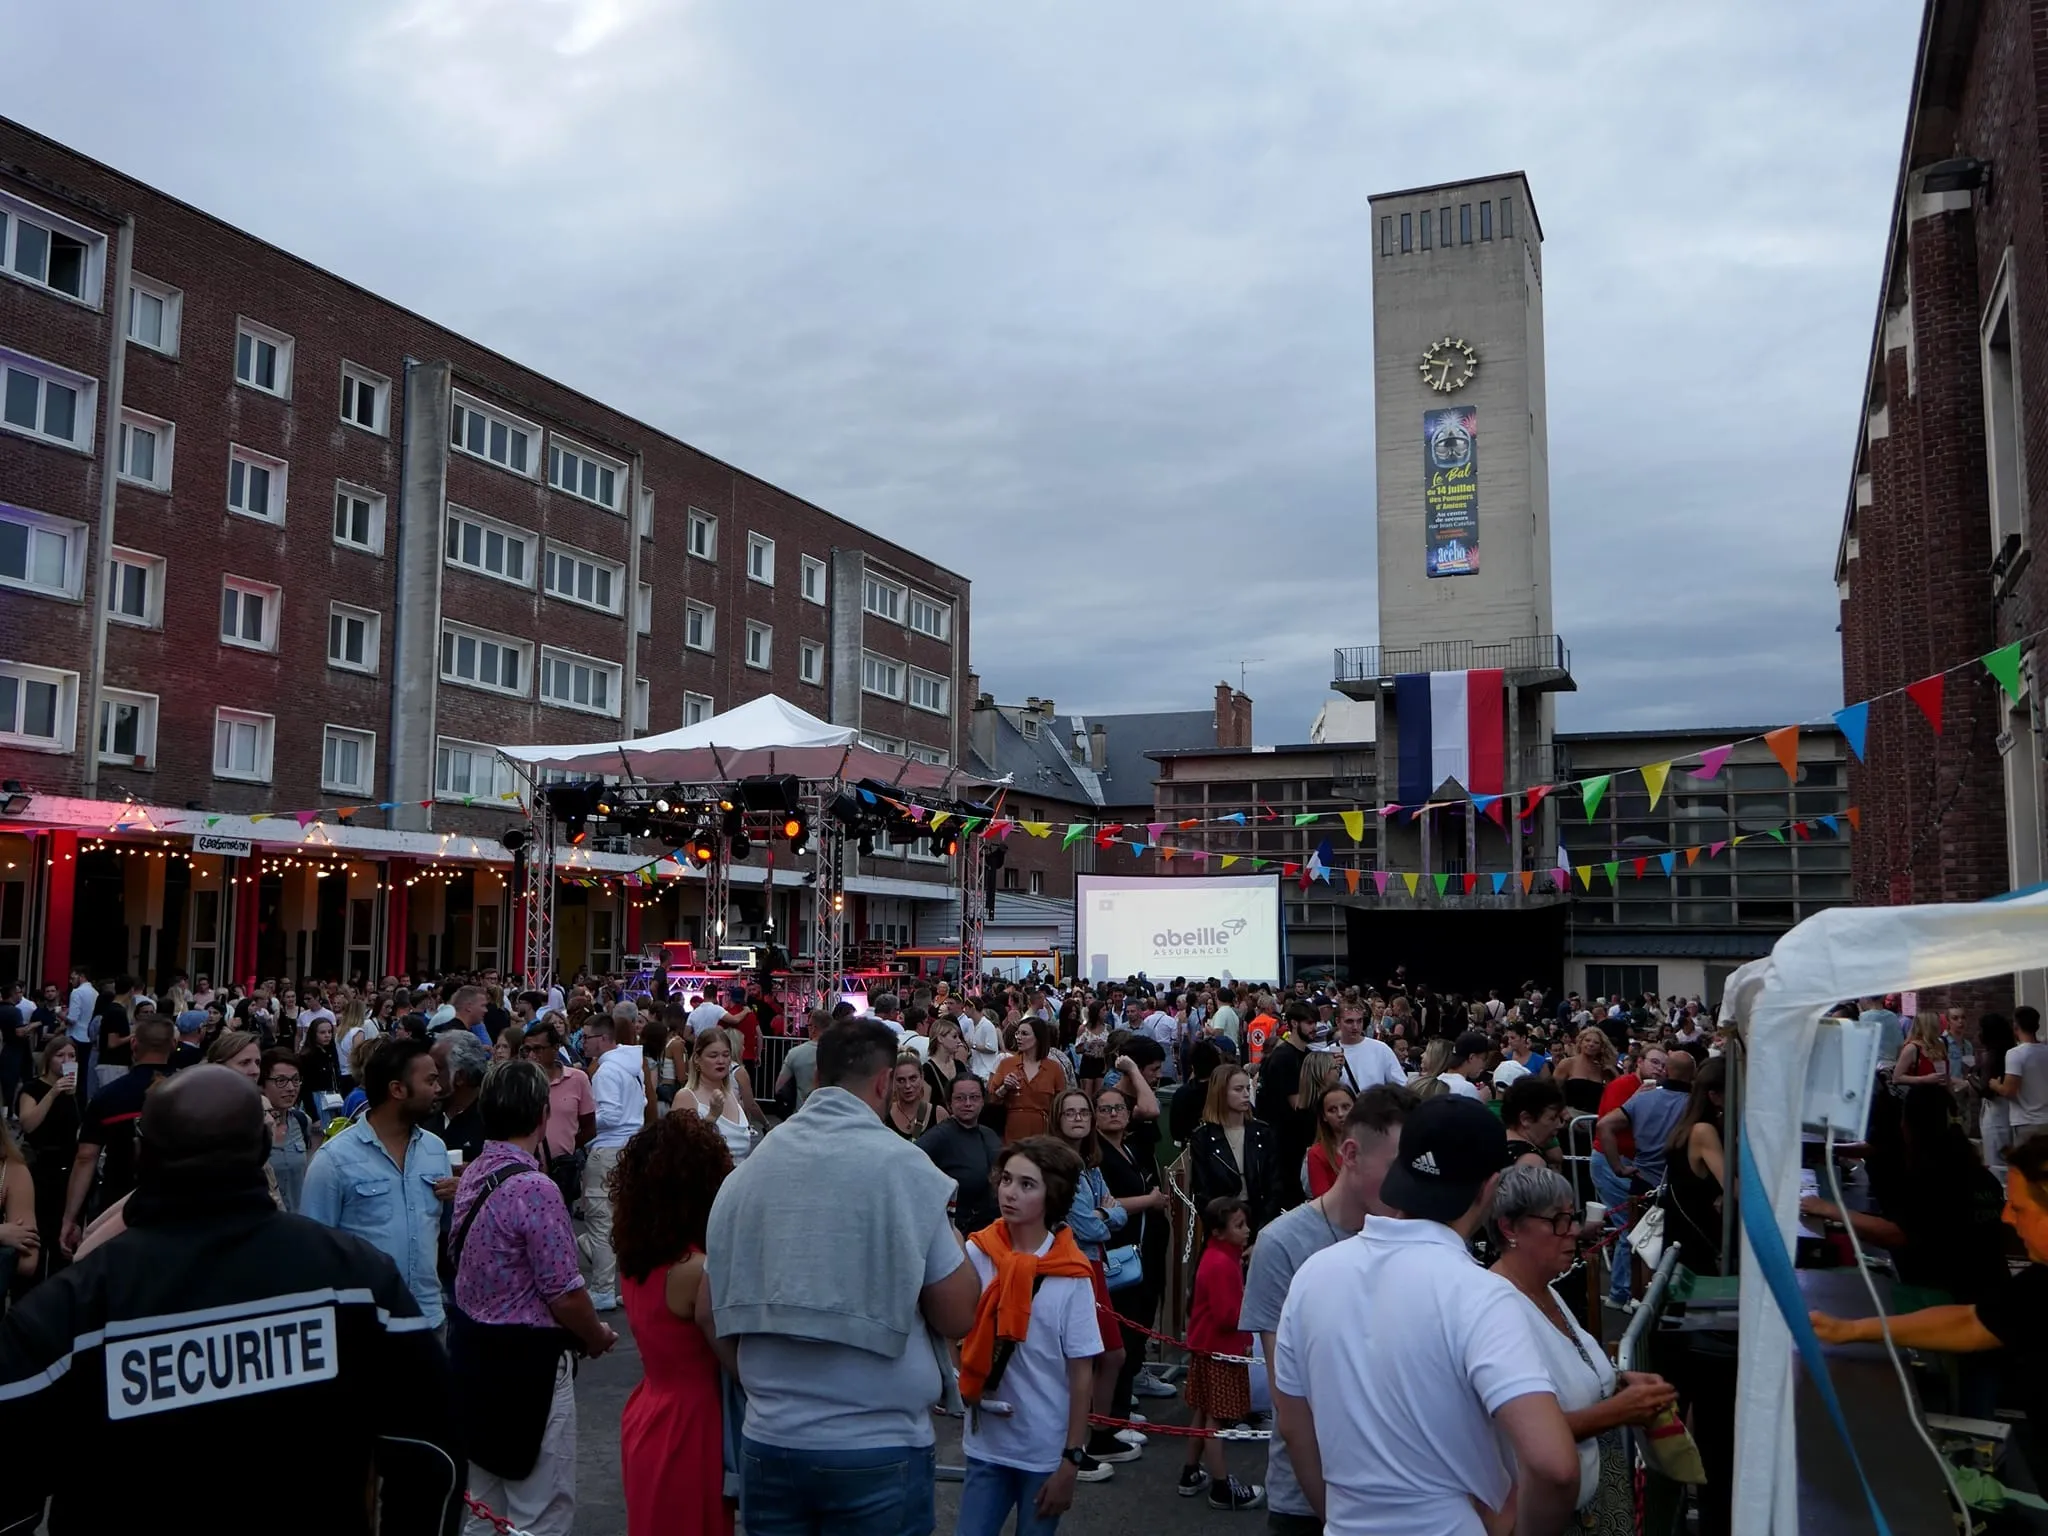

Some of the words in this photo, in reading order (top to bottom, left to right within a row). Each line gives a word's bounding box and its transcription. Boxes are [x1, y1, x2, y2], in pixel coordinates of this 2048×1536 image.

[1445, 462, 1472, 482] Bal
[1437, 486, 1447, 495] 14
[1448, 484, 1475, 494] juillet
[1152, 927, 1230, 947] abeille
[1154, 947, 1229, 956] ASSURANCES
[1412, 1161, 1440, 1175] adidas
[120, 1317, 326, 1406] SECURITE
